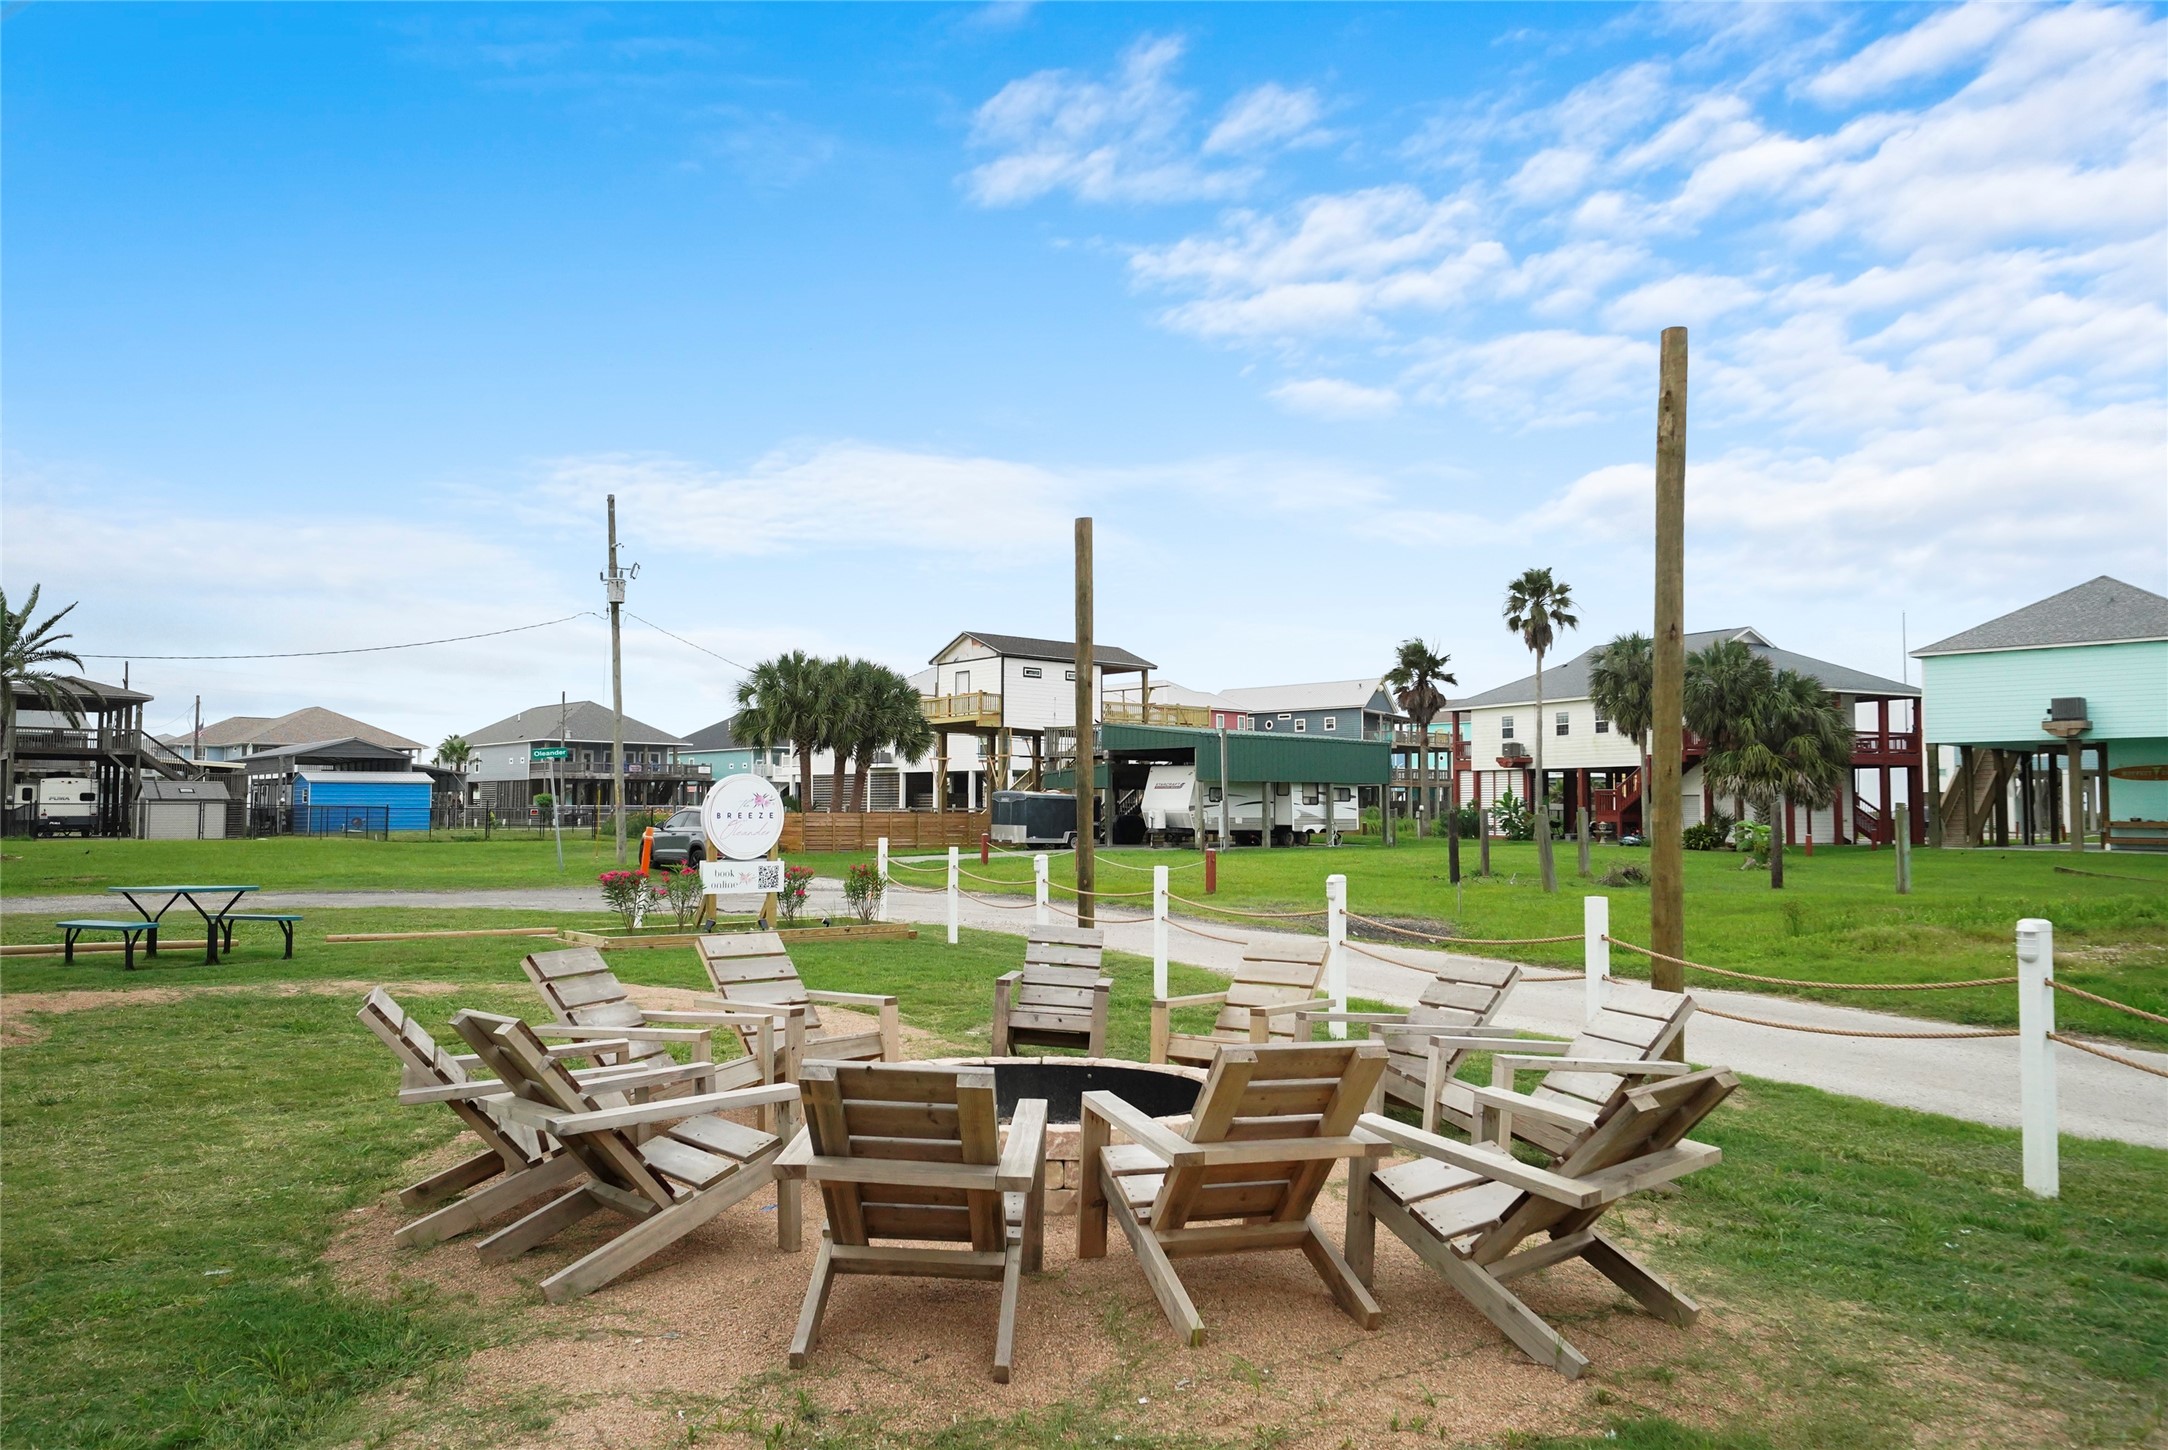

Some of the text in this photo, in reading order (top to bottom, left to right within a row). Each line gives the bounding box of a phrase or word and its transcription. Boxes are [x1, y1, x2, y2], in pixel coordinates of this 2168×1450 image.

[716, 812, 774, 820] BREEZE
[714, 869, 735, 877] book
[710, 881, 739, 889] online
